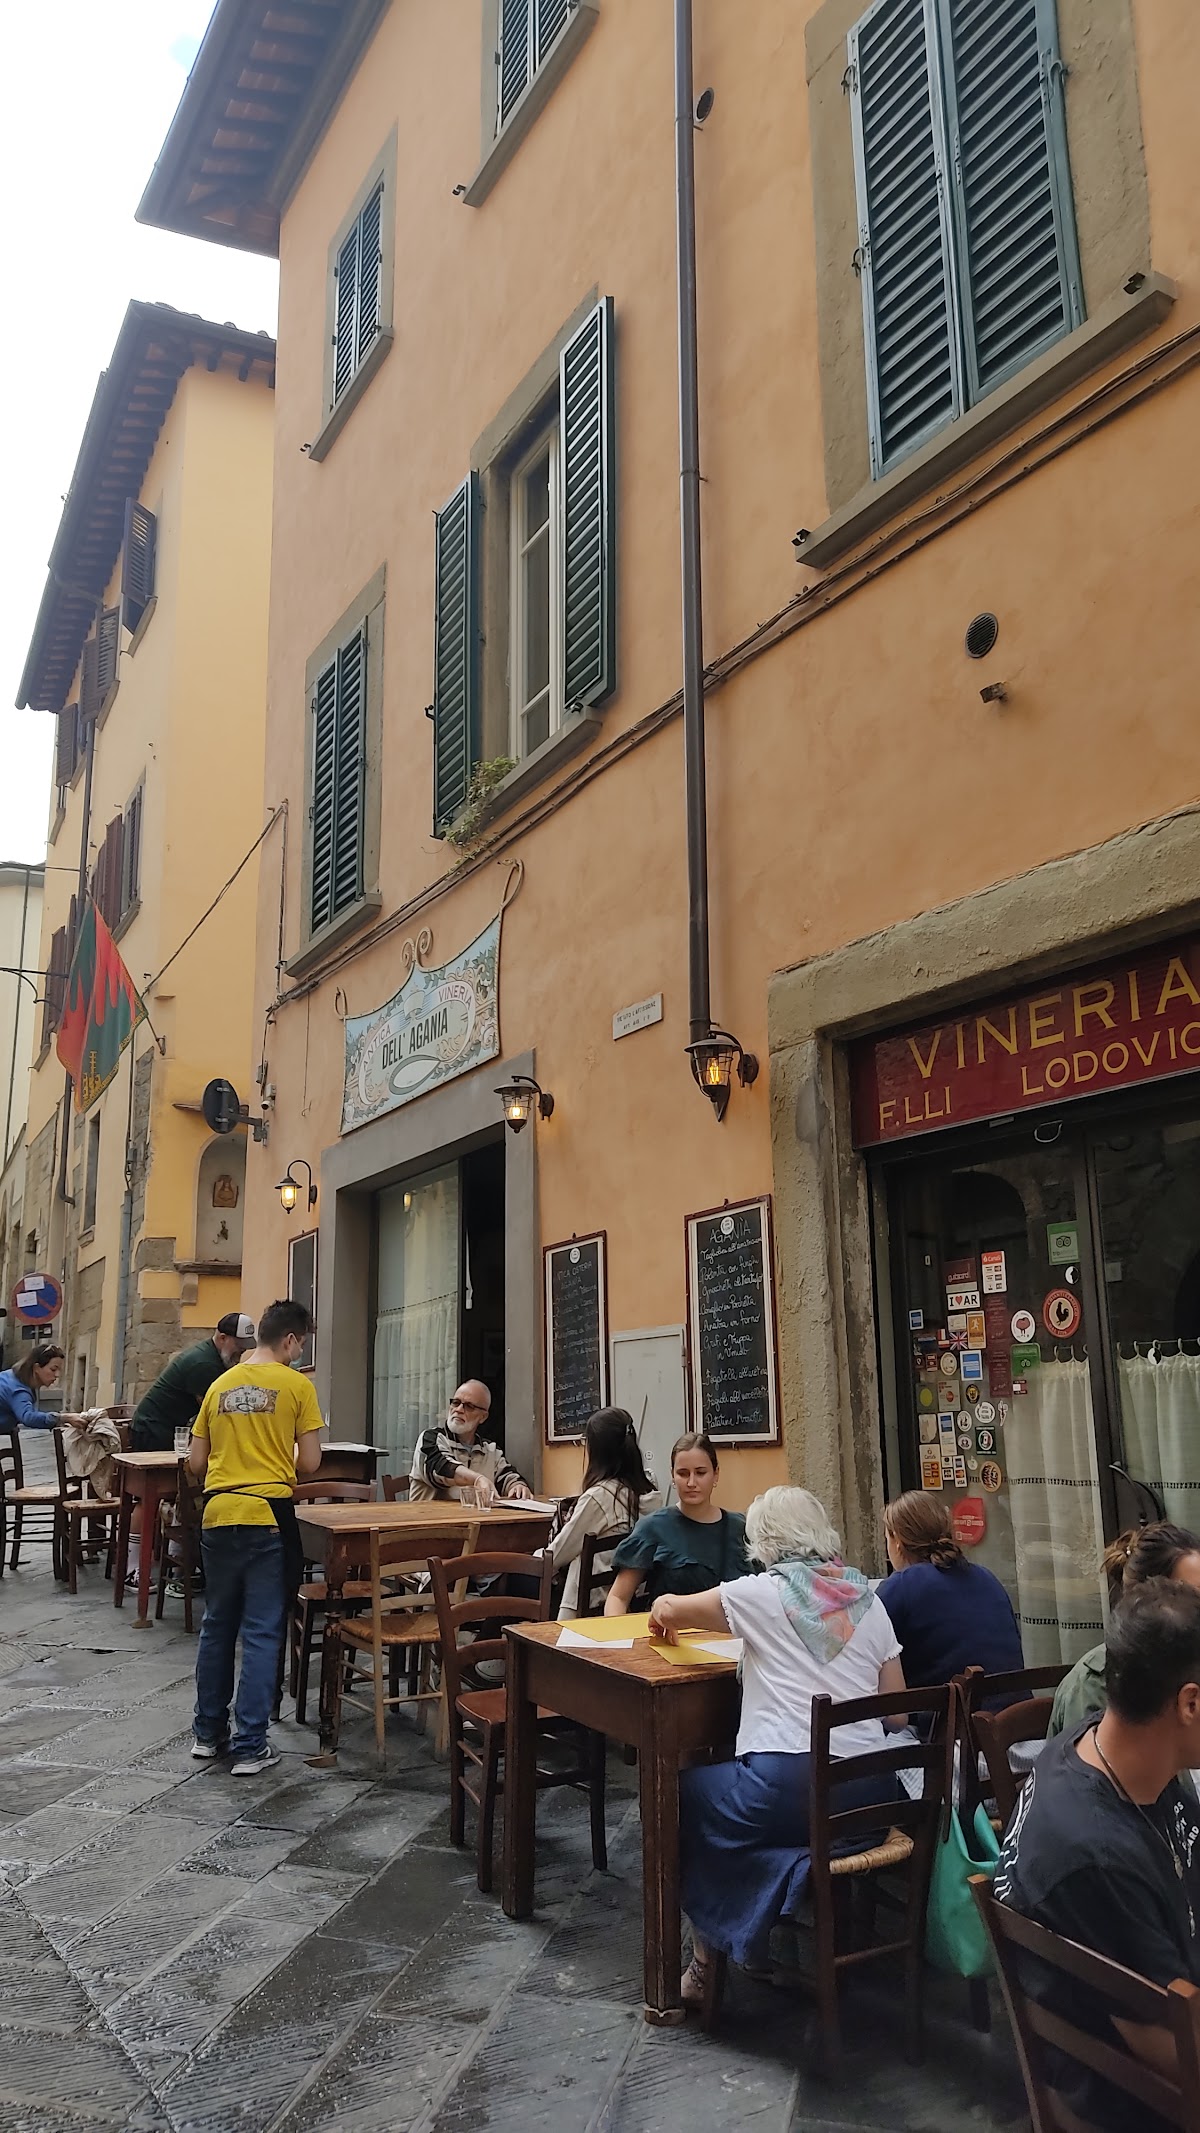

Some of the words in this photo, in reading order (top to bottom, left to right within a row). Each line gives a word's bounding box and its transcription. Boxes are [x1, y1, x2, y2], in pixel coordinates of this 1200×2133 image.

[438, 984, 472, 1010] VINERIA
[906, 956, 1200, 1079] VINERIA
[363, 1024, 391, 1068] ANTICA
[381, 1032, 406, 1070] DELL'
[408, 1007, 448, 1055] AGANIA
[879, 1086, 952, 1131] F.LLI
[949, 1297, 955, 1307] I
[963, 1294, 978, 1306] AR
